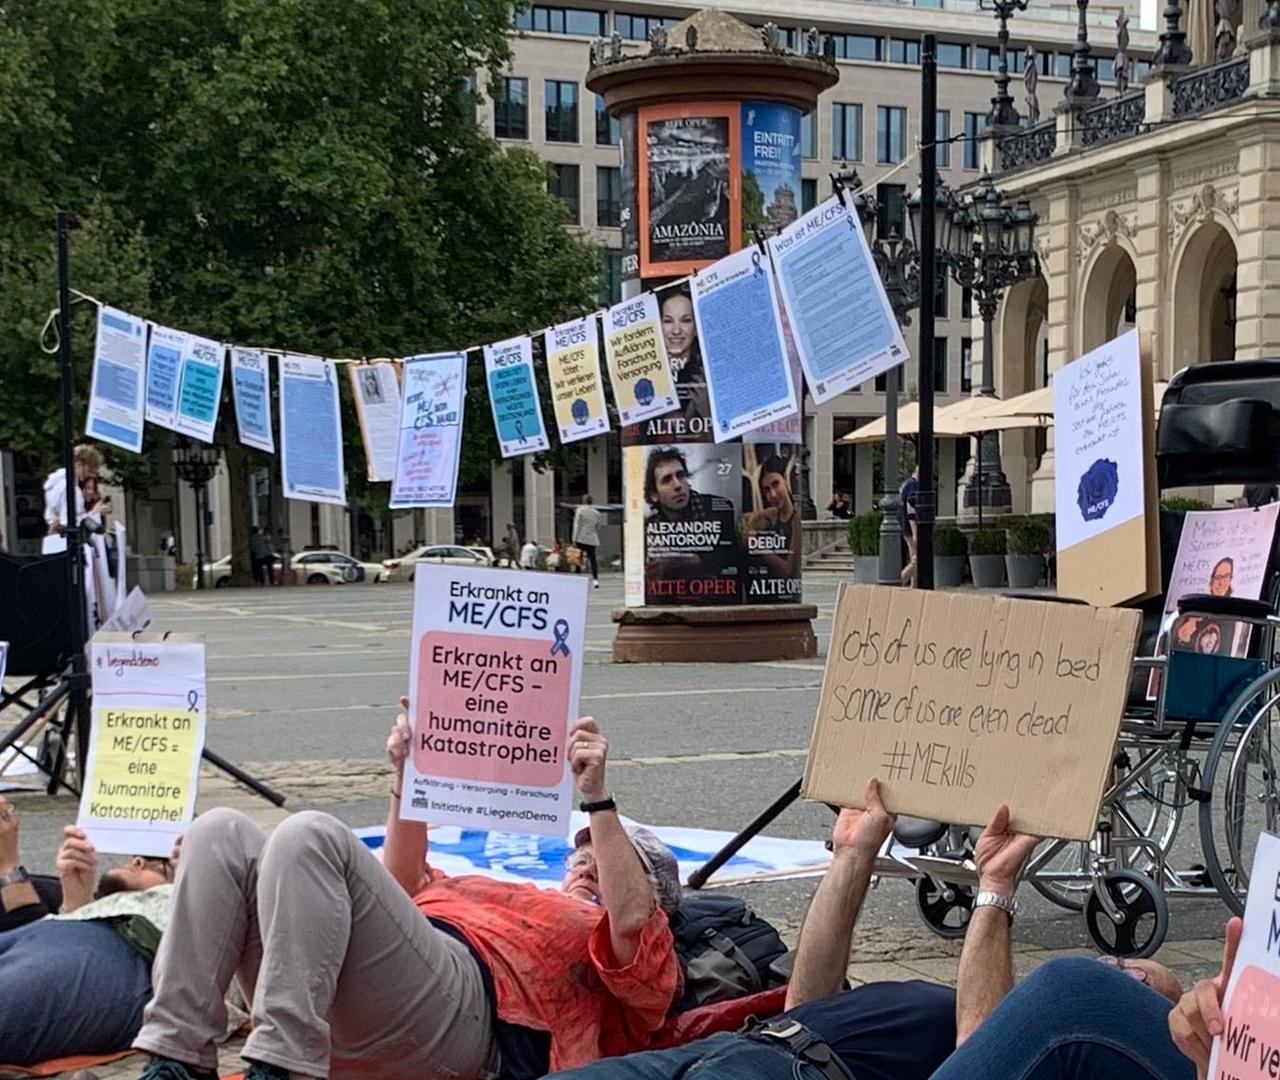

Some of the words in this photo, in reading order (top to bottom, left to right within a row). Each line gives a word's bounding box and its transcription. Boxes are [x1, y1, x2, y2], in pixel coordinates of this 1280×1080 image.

[754, 131, 794, 147] EINTRITT
[653, 221, 724, 238] AMAZÔNIA
[612, 308, 646, 329] ME/CFS
[555, 332, 586, 348] ME/CFS
[494, 352, 522, 367] ME/CFS
[559, 350, 585, 365] ME/CFS
[617, 350, 657, 369] Forschung
[617, 360, 662, 382] Versorgung
[647, 418, 686, 435] ALTE
[717, 464, 733, 476] 27
[647, 521, 721, 533] ALEXANDRE
[647, 535, 720, 546] KANTOROW
[450, 581, 522, 602] Erkrankt
[527, 590, 550, 604] an
[649, 580, 686, 595] ALTE
[690, 579, 737, 595] OPER
[750, 578, 786, 595] ALTE
[448, 601, 548, 630] ME/CFS
[432, 646, 523, 670] Erkrankt
[530, 657, 558, 674] an
[942, 647, 971, 671] are
[976, 629, 1021, 689] lying
[1028, 650, 1044, 672] in
[1056, 643, 1101, 681] bed
[443, 669, 524, 693] ME/CFS
[465, 696, 508, 715] eine
[107, 712, 167, 730] Erkrankt
[172, 716, 191, 730] an
[429, 712, 552, 741] humanitäre
[938, 703, 962, 727] are
[969, 704, 1009, 734] even
[1016, 704, 1071, 737] dead
[113, 735, 168, 753] ME/CFS
[421, 734, 558, 764] Katastrophe!
[128, 761, 157, 775] eine
[882, 740, 976, 789] #MEkills
[99, 780, 181, 799] humanitäre
[461, 784, 508, 797] Versorgung
[516, 788, 559, 801] Forschung
[89, 803, 184, 825] Katastrophe!
[431, 800, 473, 814] Initiative
[476, 804, 558, 822] #LiegendDemo
[1223, 1016, 1256, 1062] Wir
